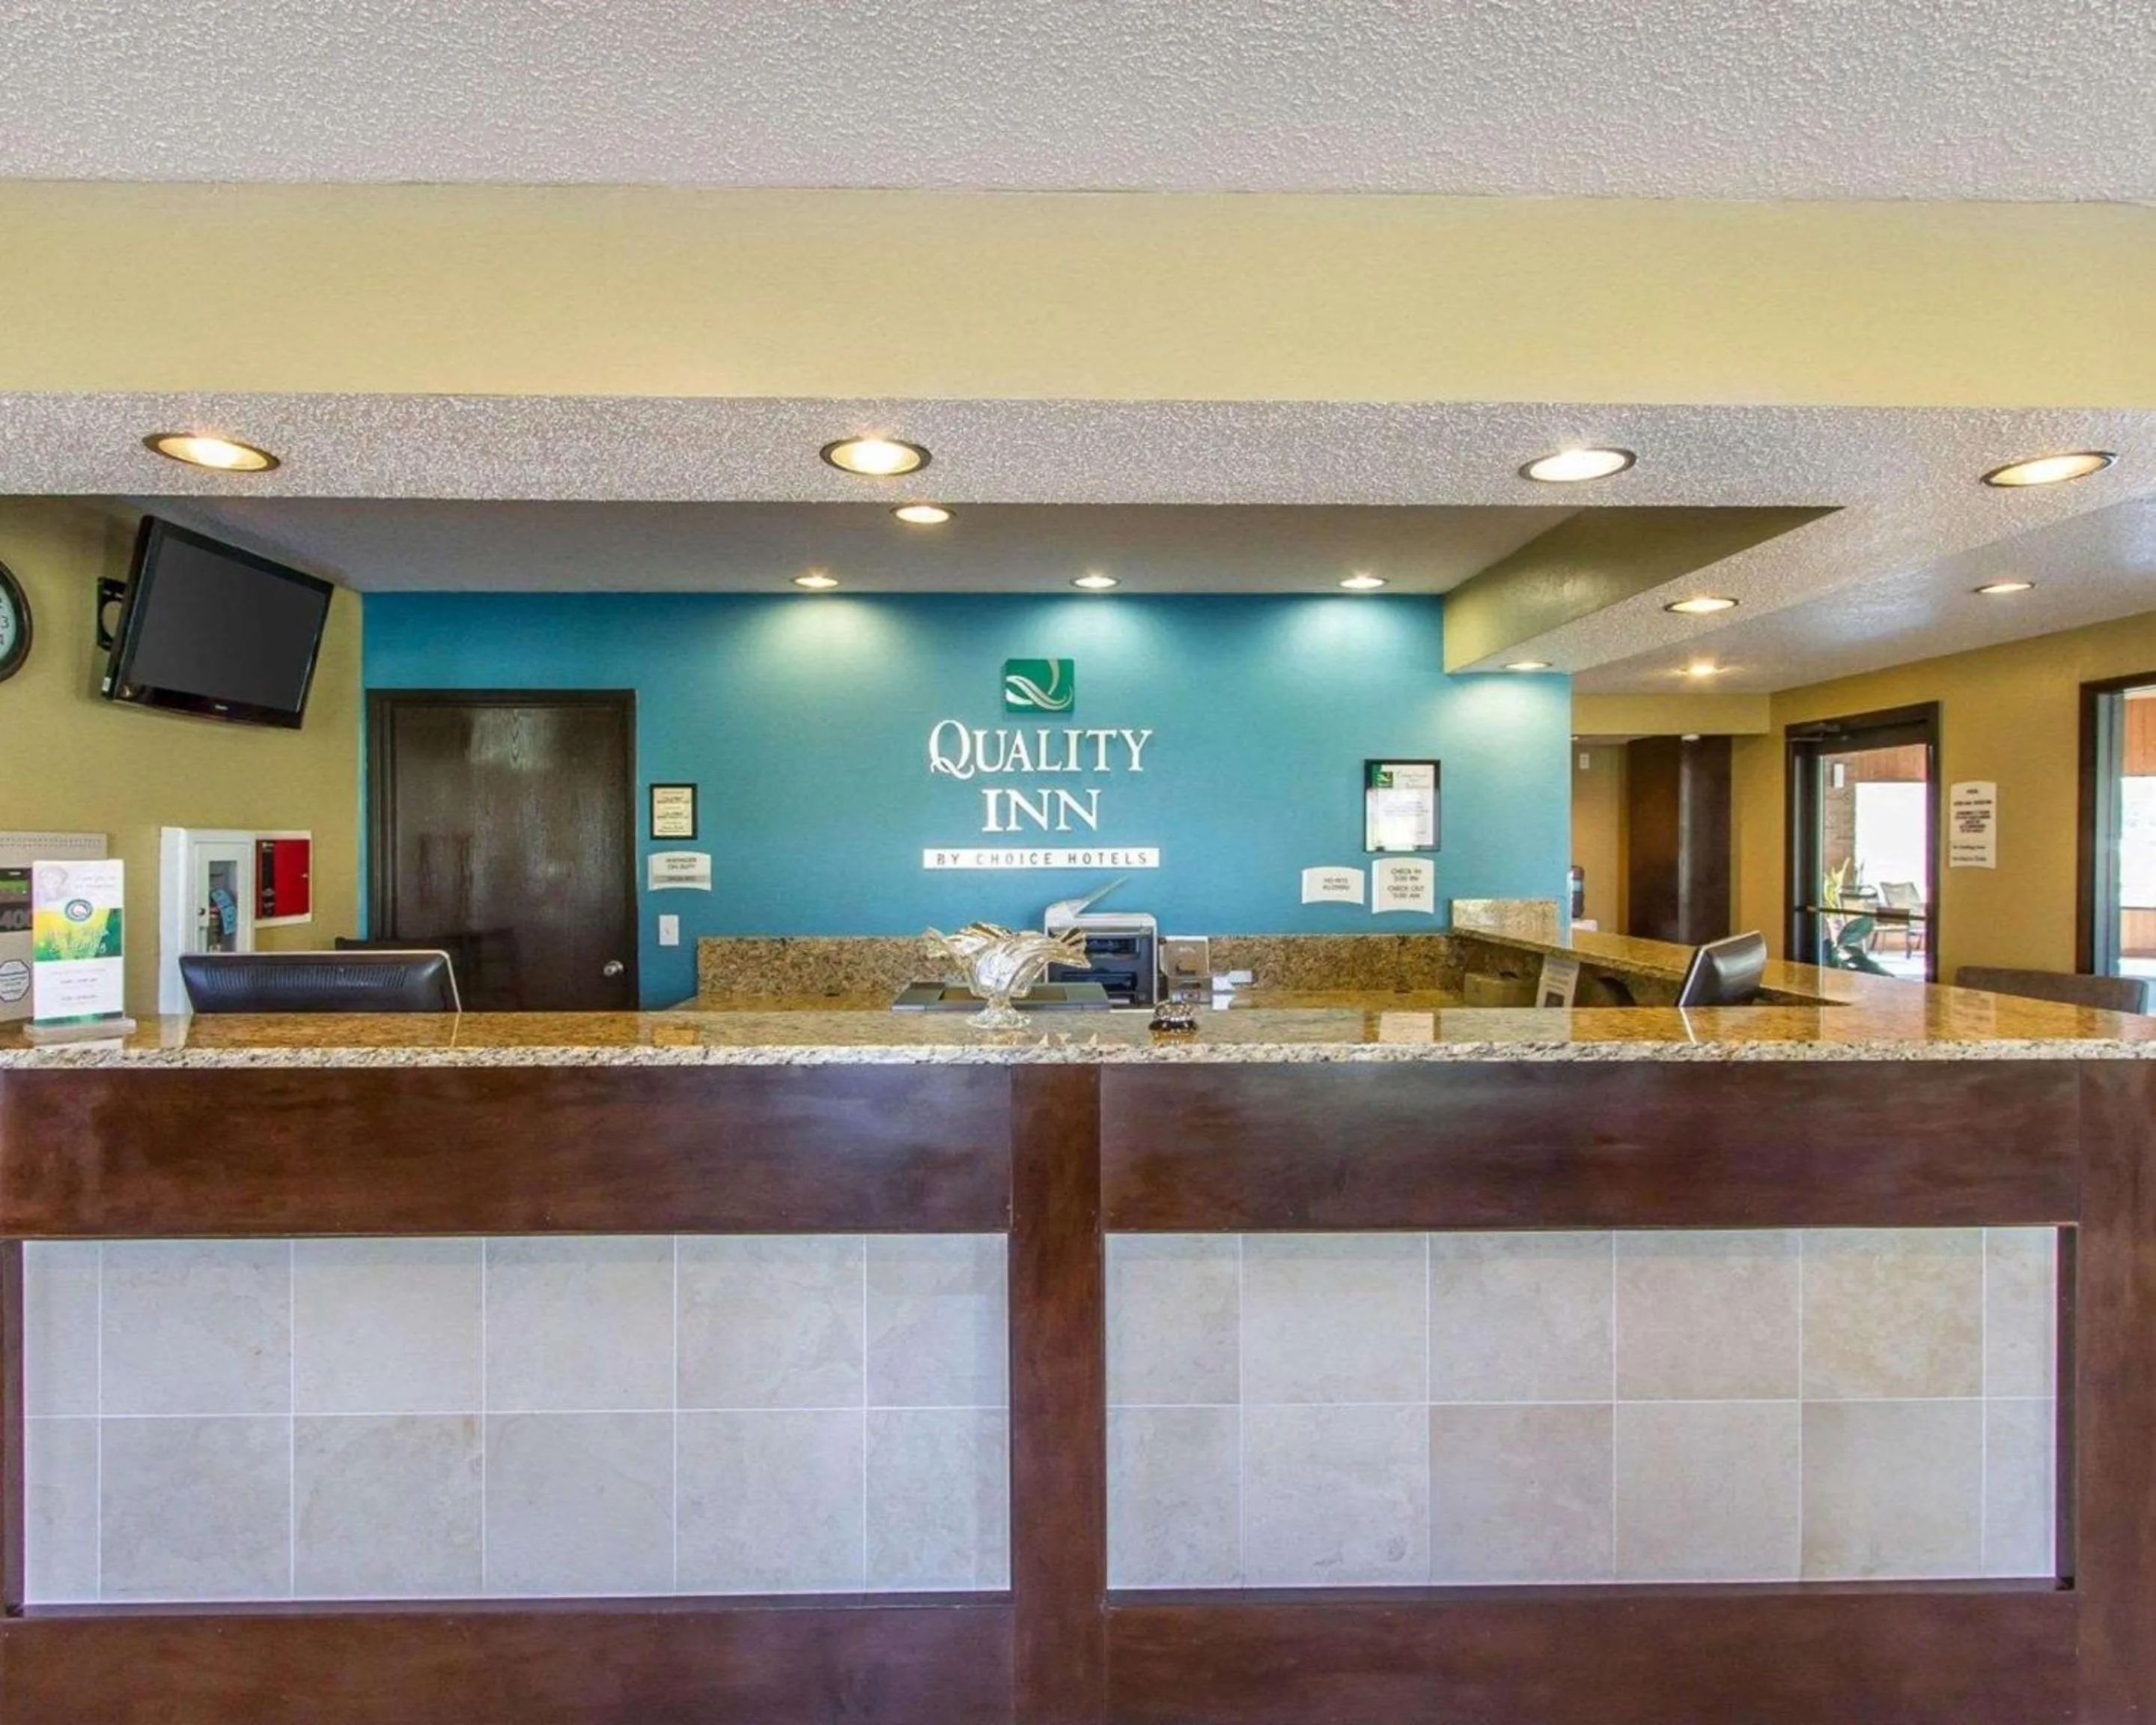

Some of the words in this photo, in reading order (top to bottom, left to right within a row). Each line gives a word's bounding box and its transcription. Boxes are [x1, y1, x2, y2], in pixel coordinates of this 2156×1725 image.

[929, 719, 1153, 779] QUALITY
[981, 789, 1101, 832] INN
[937, 853, 960, 865] BY
[976, 852, 1052, 865] CHOICE
[1068, 852, 1147, 864] HOTELS
